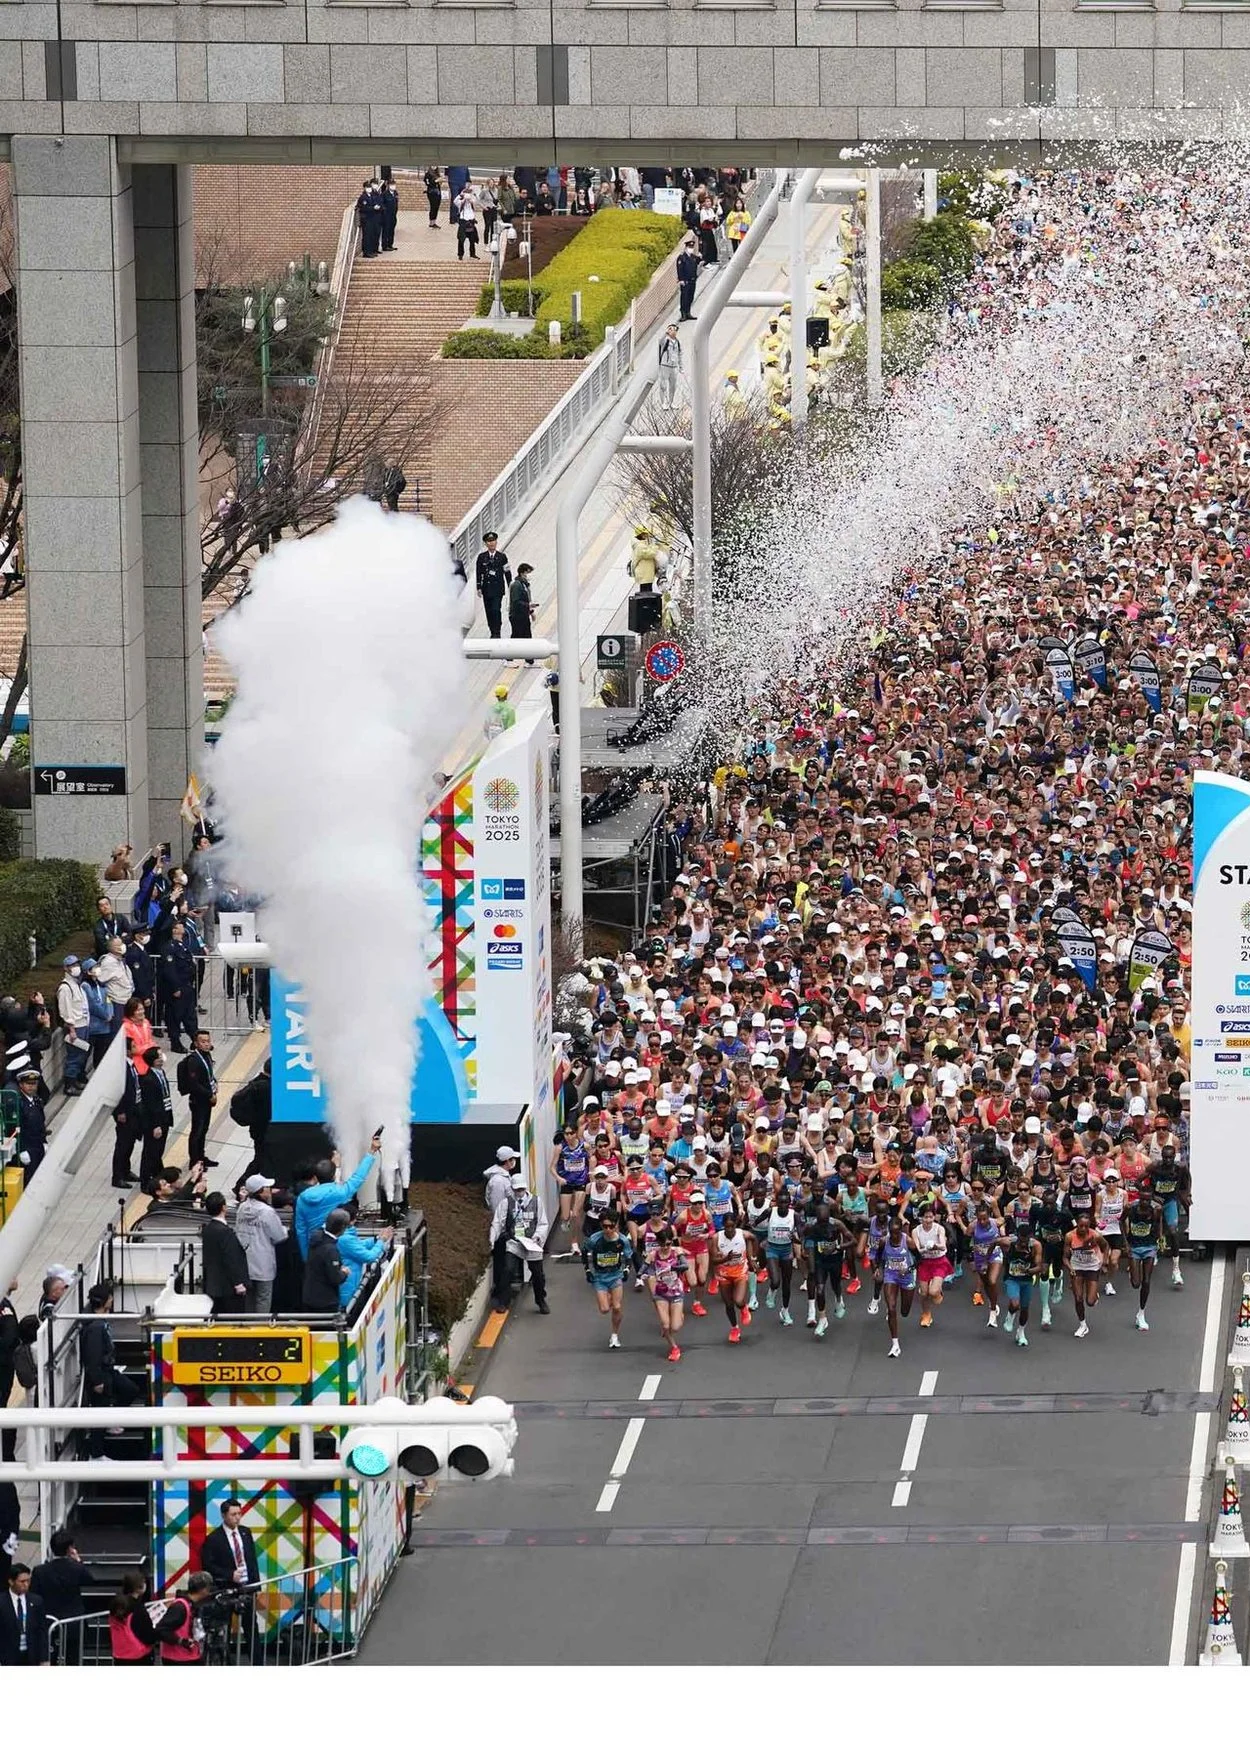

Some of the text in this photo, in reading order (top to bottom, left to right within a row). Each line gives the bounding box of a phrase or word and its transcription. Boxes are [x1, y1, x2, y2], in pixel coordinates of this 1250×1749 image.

[1140, 676, 1158, 686] 3:00
[1190, 684, 1212, 695] 3:00
[485, 815, 520, 824] TOKYO
[485, 831, 520, 841] 2025
[1070, 946, 1095, 957] 2:50
[1134, 951, 1158, 965] 2:50
[199, 1365, 282, 1382] SEIKO
